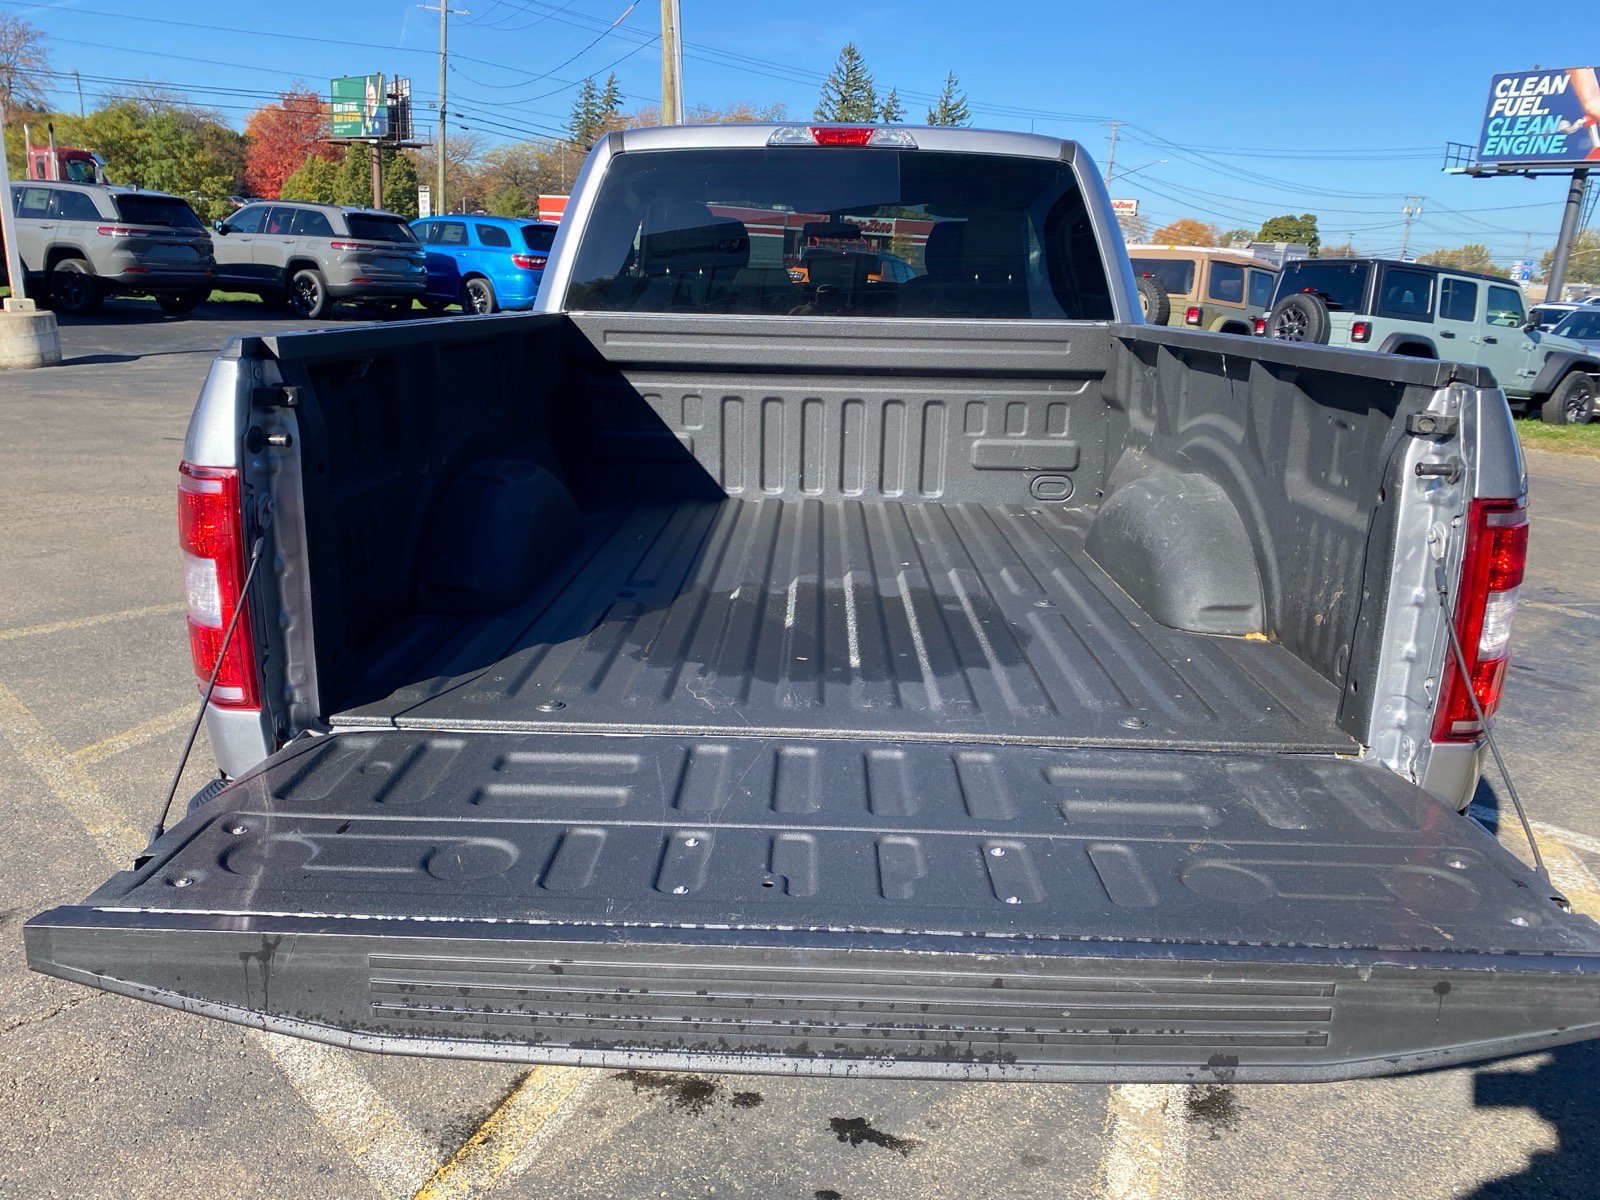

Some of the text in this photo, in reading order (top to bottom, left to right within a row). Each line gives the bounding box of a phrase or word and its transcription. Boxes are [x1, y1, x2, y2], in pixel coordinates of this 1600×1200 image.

[1495, 75, 1571, 98] CLEAN
[1489, 96, 1550, 118] FUEL.
[1487, 115, 1563, 137] CLEAN
[1481, 134, 1568, 156] ENGINE.
[1111, 201, 1133, 209] oZone
